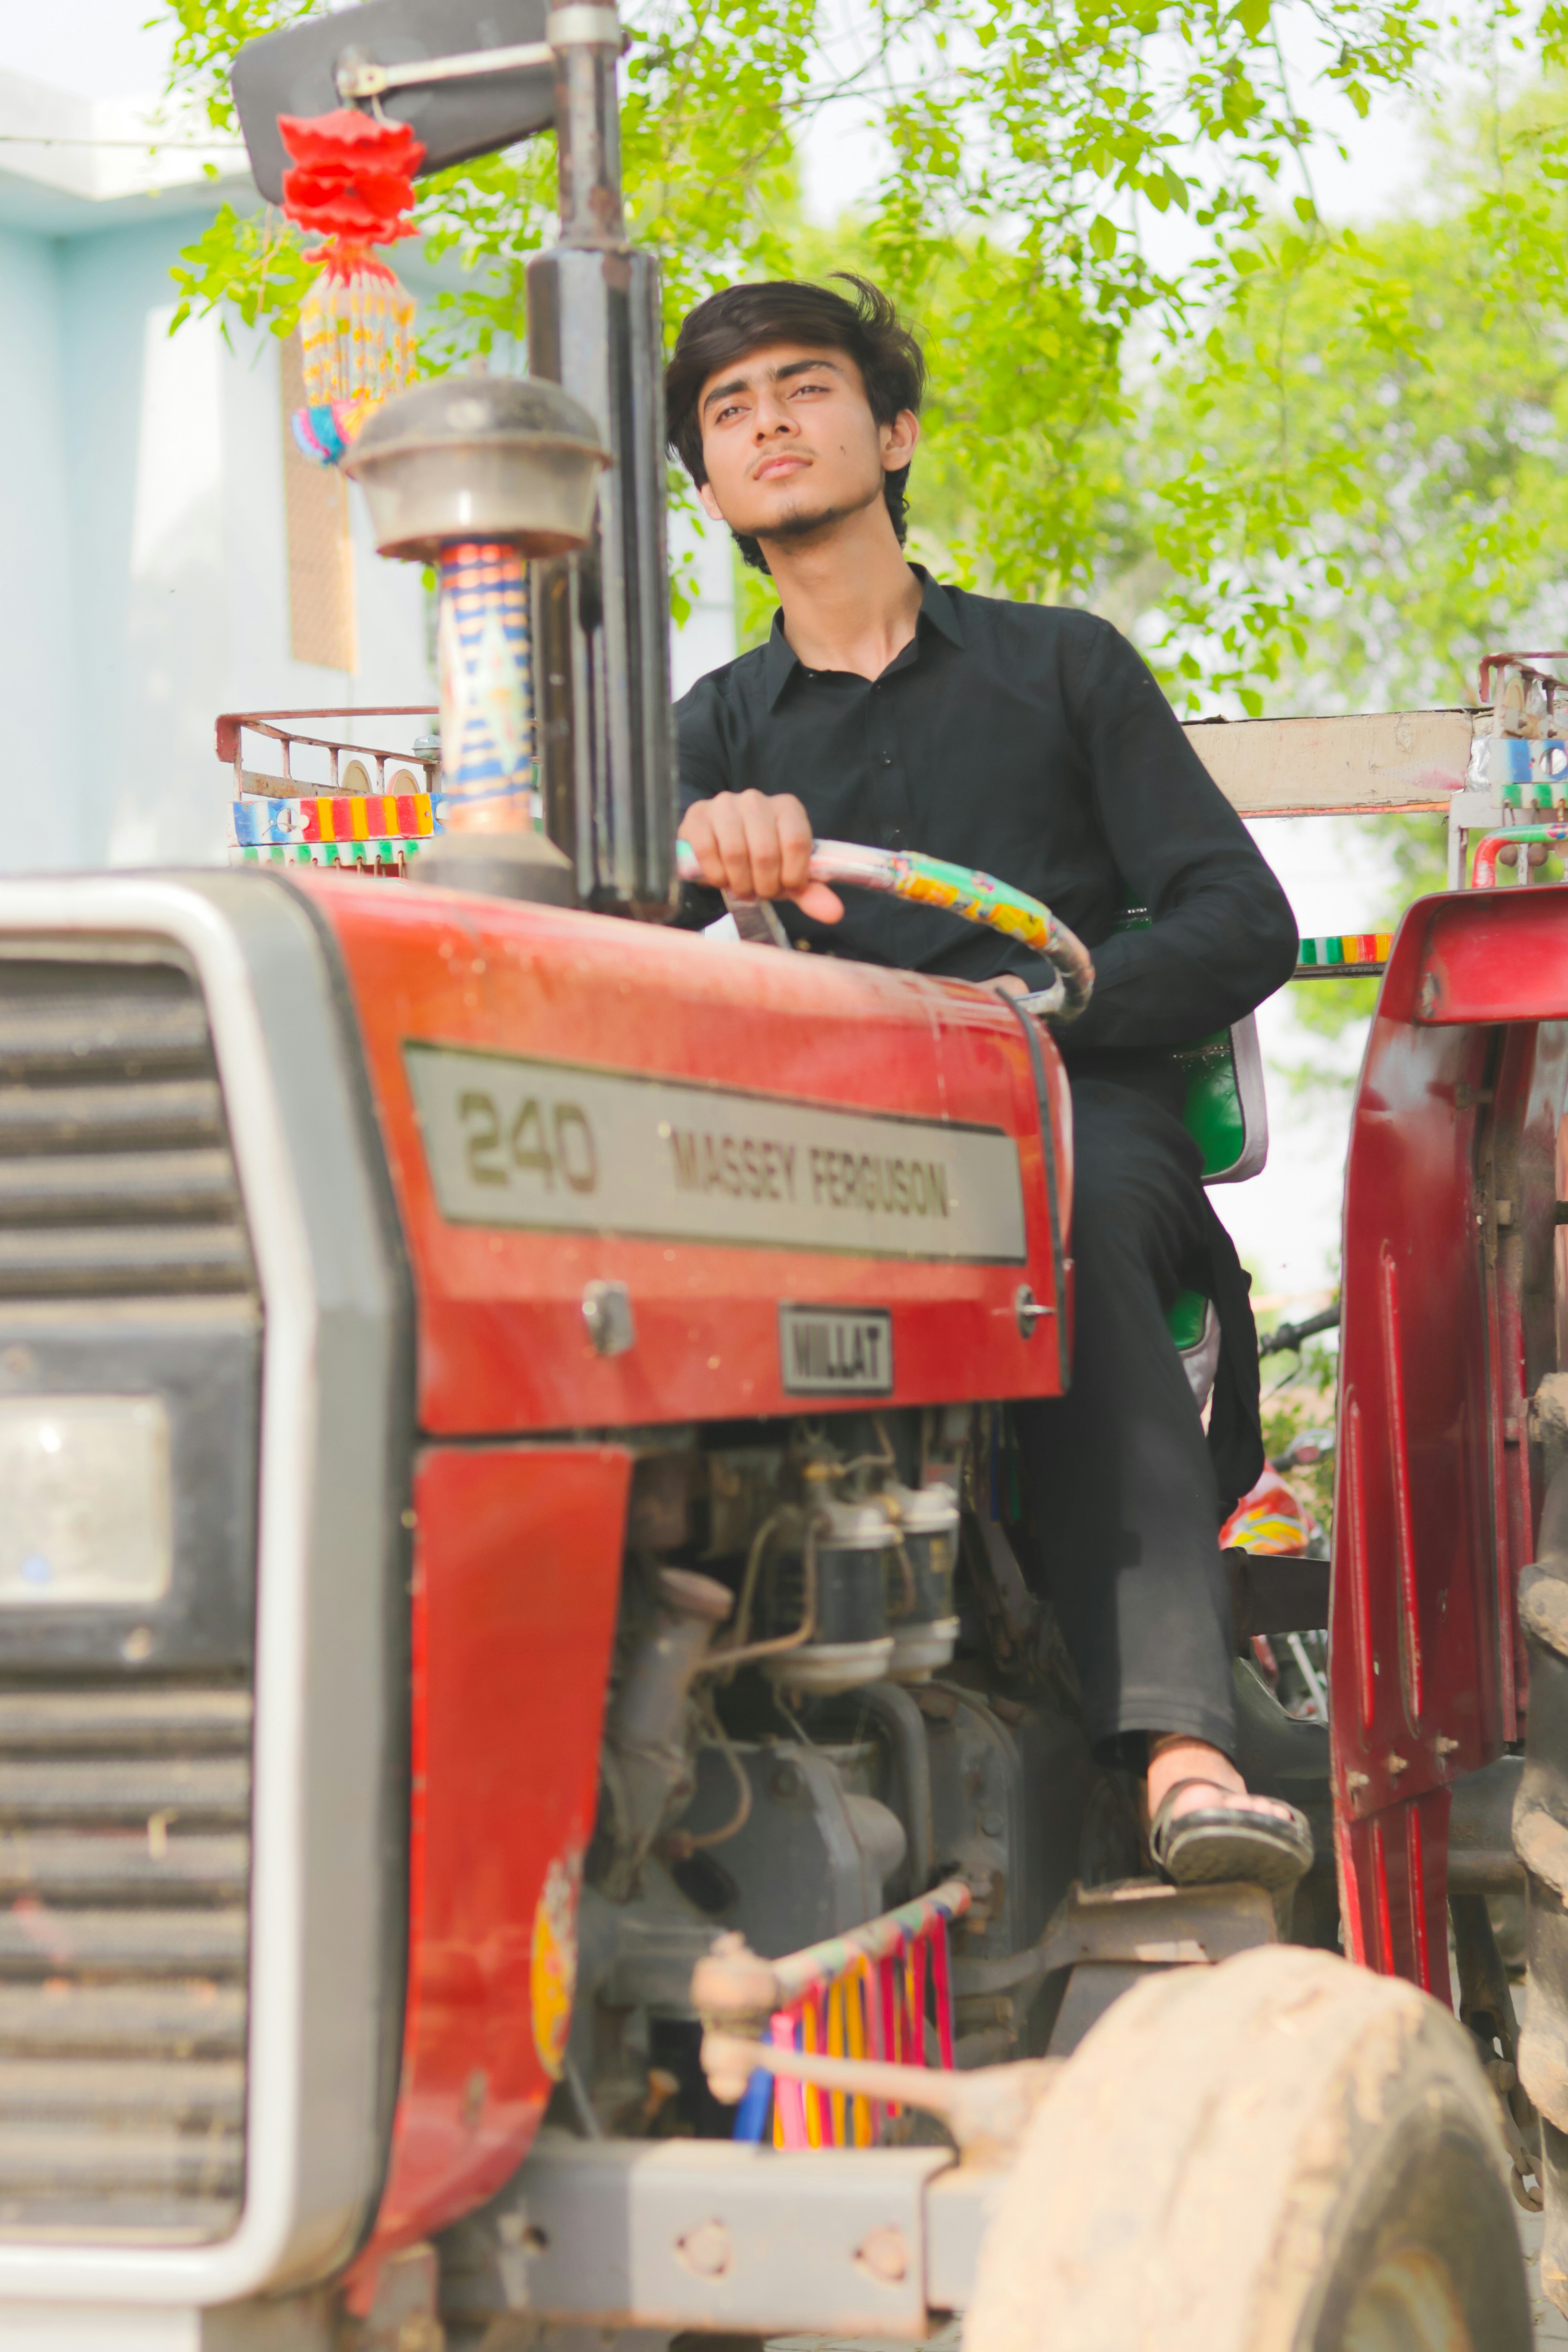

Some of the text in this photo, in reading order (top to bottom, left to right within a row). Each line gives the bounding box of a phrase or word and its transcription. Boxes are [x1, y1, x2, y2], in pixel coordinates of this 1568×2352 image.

[458, 1090, 949, 1218] 240 MASSEY FERGUSON
